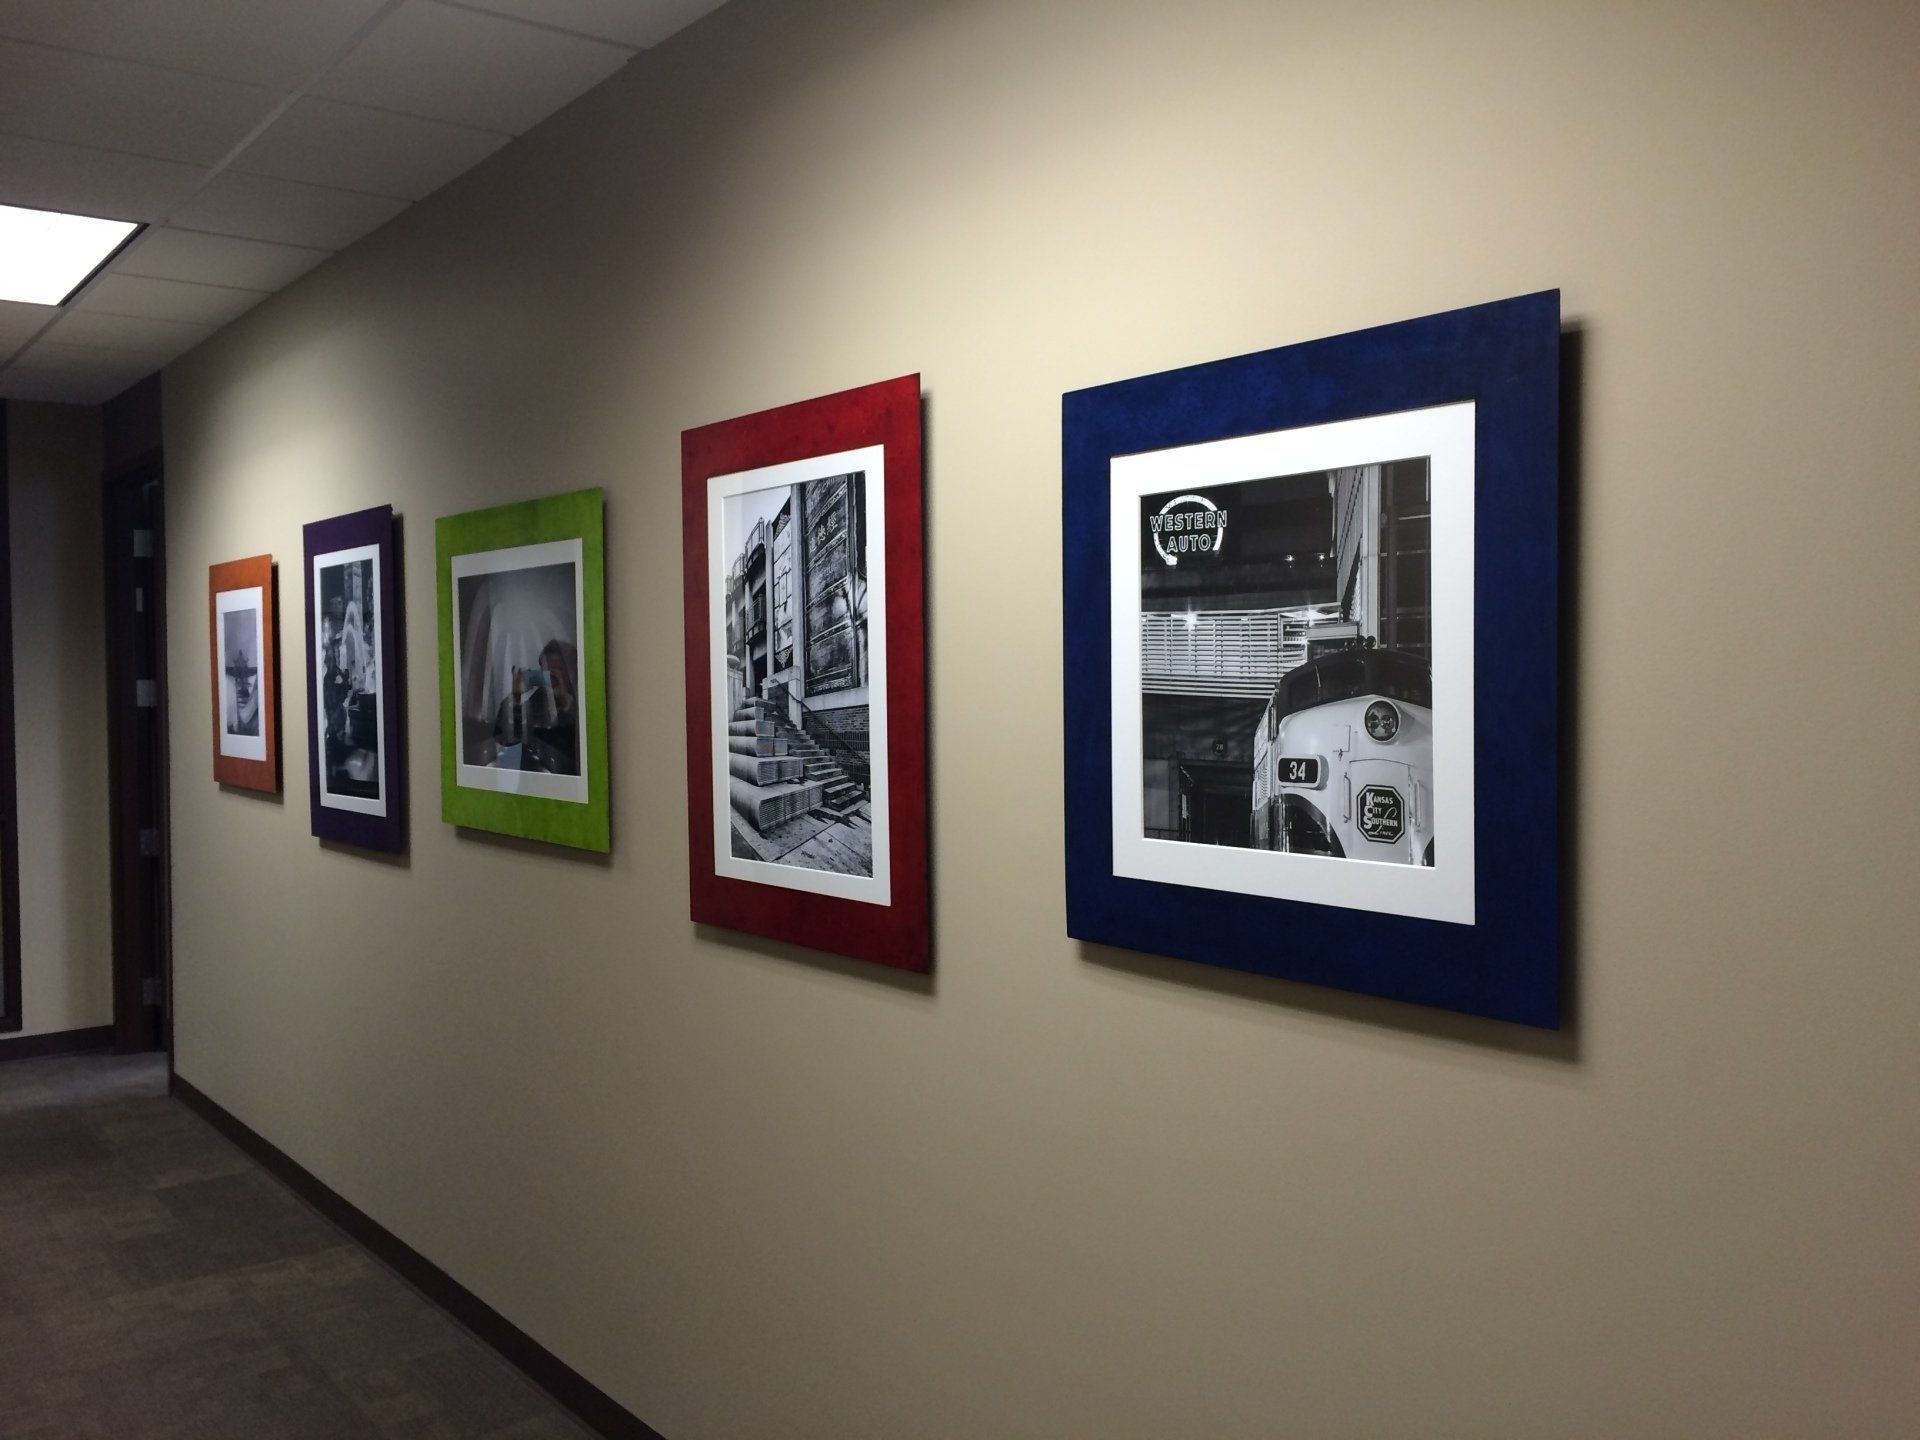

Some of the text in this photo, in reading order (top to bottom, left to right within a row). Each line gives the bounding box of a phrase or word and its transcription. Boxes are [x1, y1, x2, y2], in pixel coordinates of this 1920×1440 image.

[1149, 510, 1228, 533] WESTERN
[1166, 533, 1212, 553] AUTO
[1289, 761, 1306, 780] 34
[1365, 792, 1394, 806] KANSAS
[1363, 815, 1398, 829] SOUTHERN
